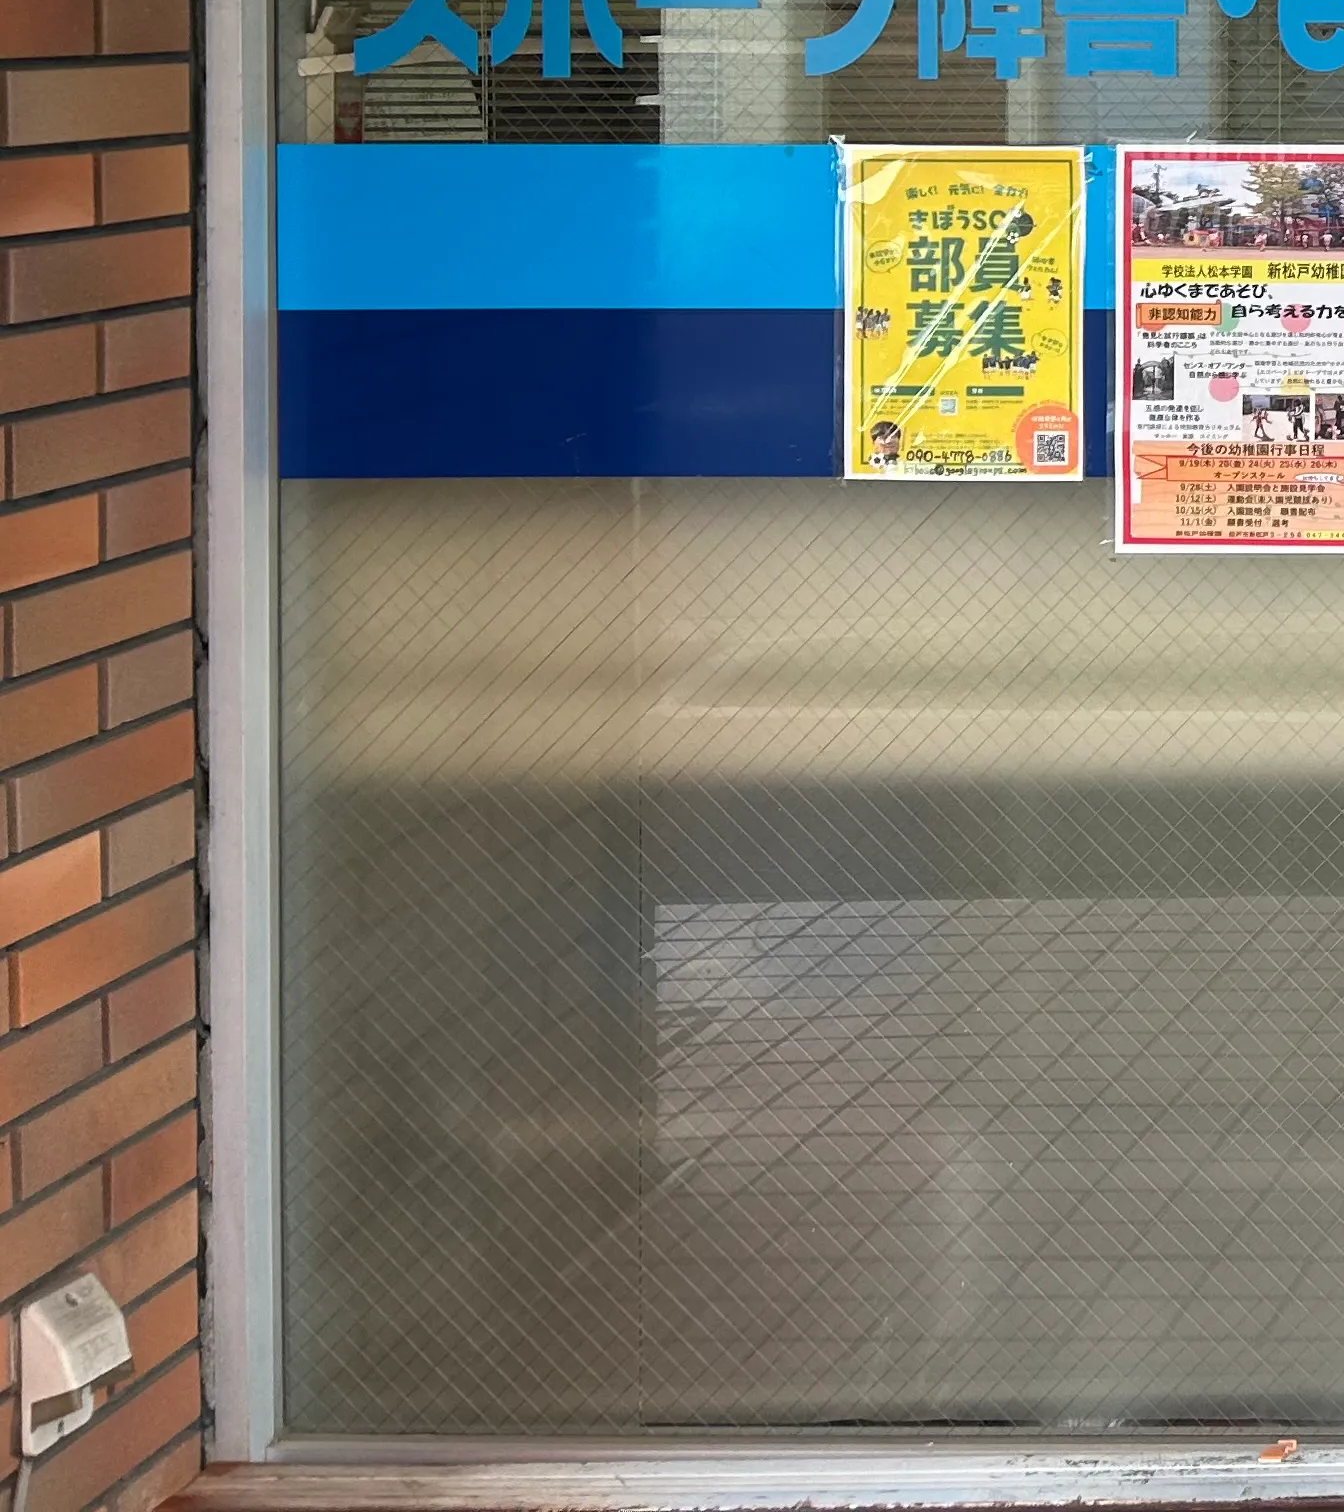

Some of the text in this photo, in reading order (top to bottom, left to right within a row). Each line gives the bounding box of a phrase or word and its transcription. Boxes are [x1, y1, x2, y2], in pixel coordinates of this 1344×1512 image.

[906, 235, 1024, 293] 部員
[1161, 264, 1253, 278] 学校法人松本学園
[1140, 283, 1275, 300] 心ゆくまであそび、
[1149, 308, 1217, 321] 非認知能力
[906, 299, 1026, 358] 募集
[1187, 443, 1325, 456] 今後の幼稚園行事日程
[1213, 471, 1286, 479] オープンスクール
